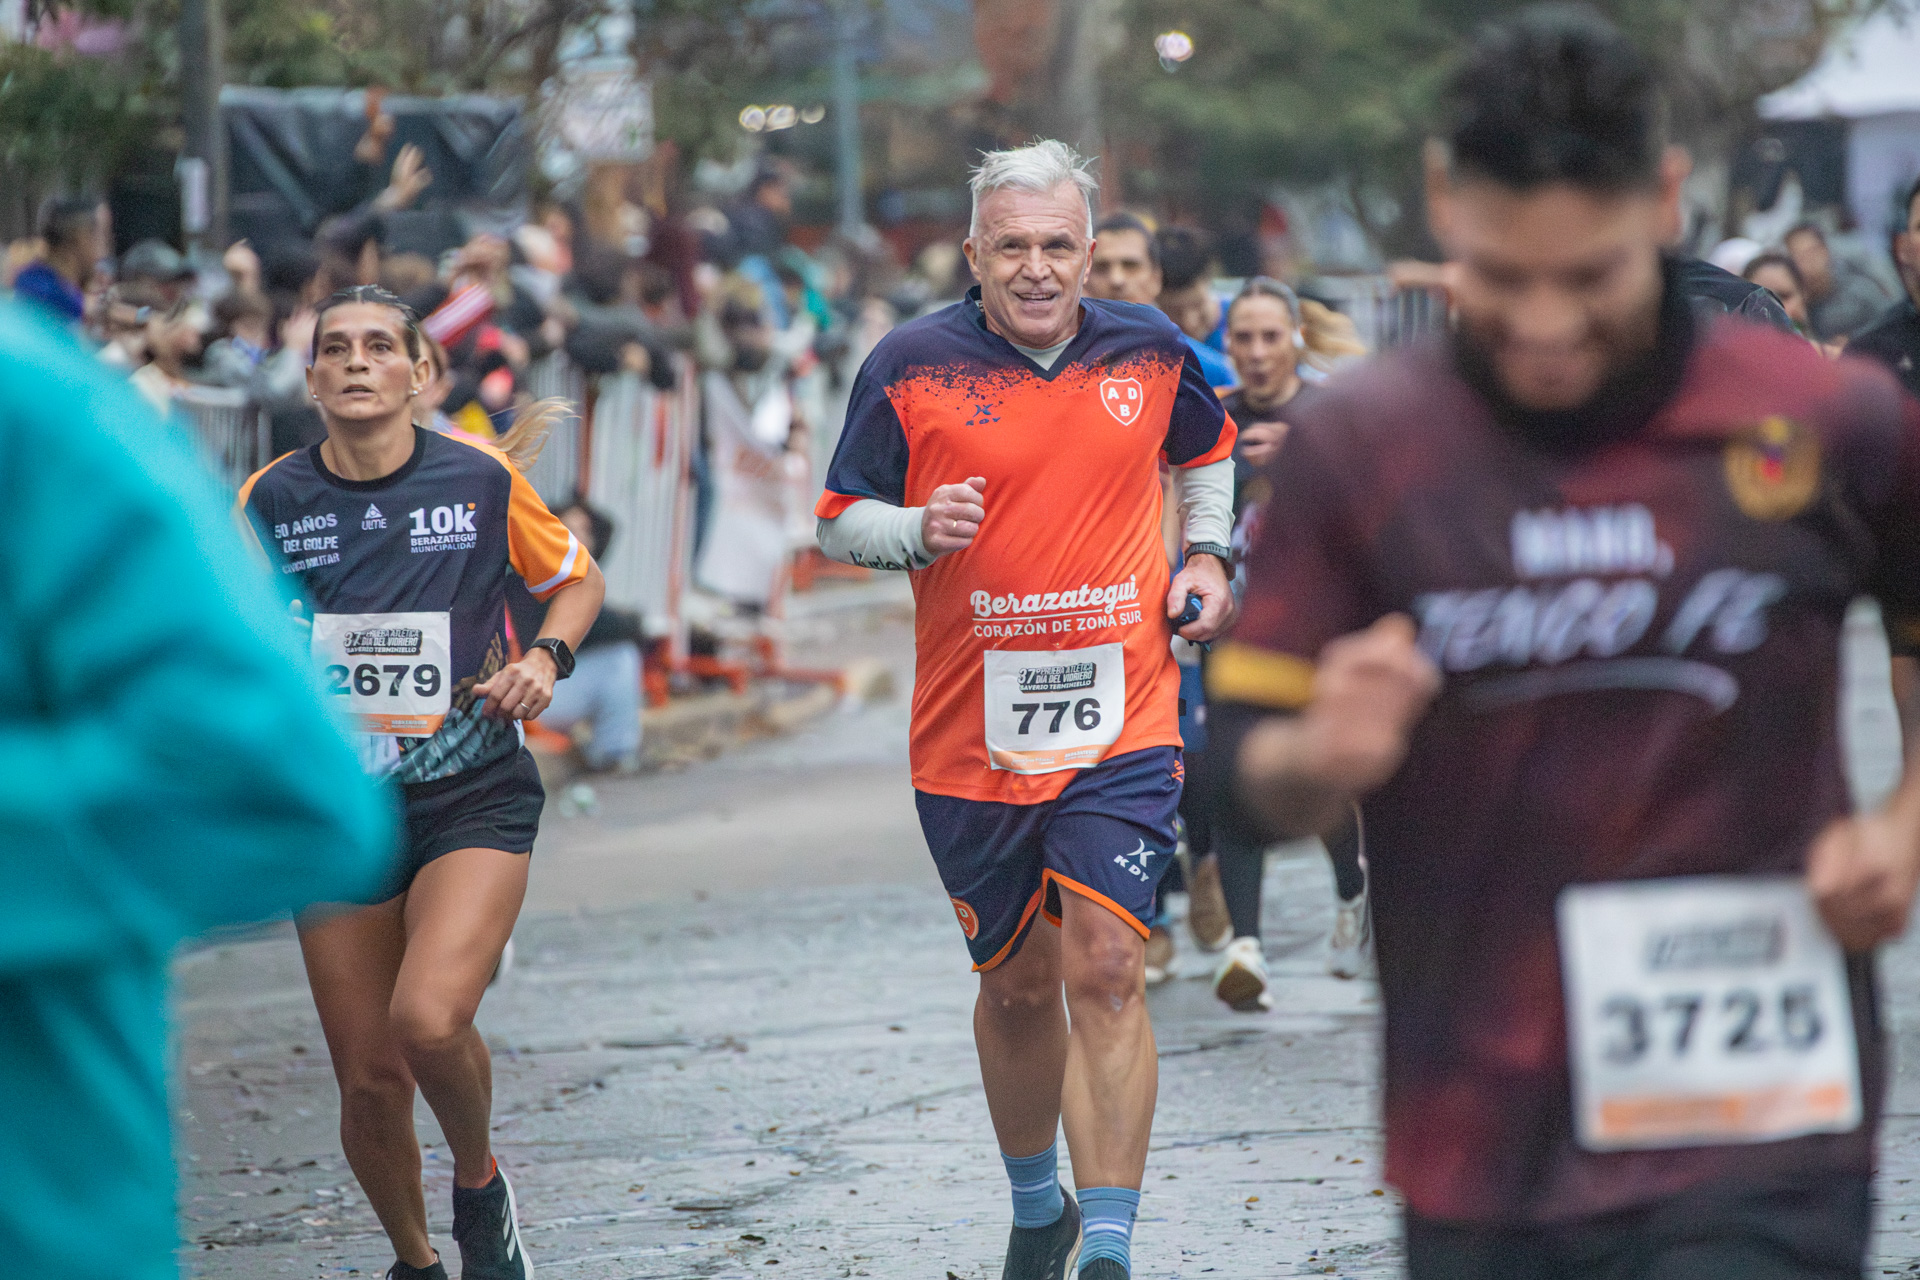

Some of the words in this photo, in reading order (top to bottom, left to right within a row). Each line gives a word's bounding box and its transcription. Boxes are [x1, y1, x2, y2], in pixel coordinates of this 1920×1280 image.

[1107, 386, 1120, 400] A
[1127, 386, 1138, 400] D
[1119, 404, 1131, 417] B
[274, 523, 289, 539] 50
[292, 513, 339, 536] AÑOS
[361, 518, 387, 531] ULME
[283, 539, 303, 554] DEL
[303, 536, 339, 551] GOLPE
[410, 533, 477, 547] BERAZATEGUI
[305, 552, 341, 569] MILITAR
[970, 573, 1139, 618] Berazategui
[973, 619, 1047, 638] CORAZÓN
[1052, 619, 1072, 634] DE
[1076, 614, 1117, 631] ZONA
[1119, 609, 1143, 627] SUR
[373, 637, 386, 647] DEL
[325, 663, 441, 697] 2679
[1048, 674, 1062, 684] DEL
[1011, 697, 1102, 735] 776
[1113, 854, 1150, 882] KDY
[1599, 986, 1823, 1063] 3725
